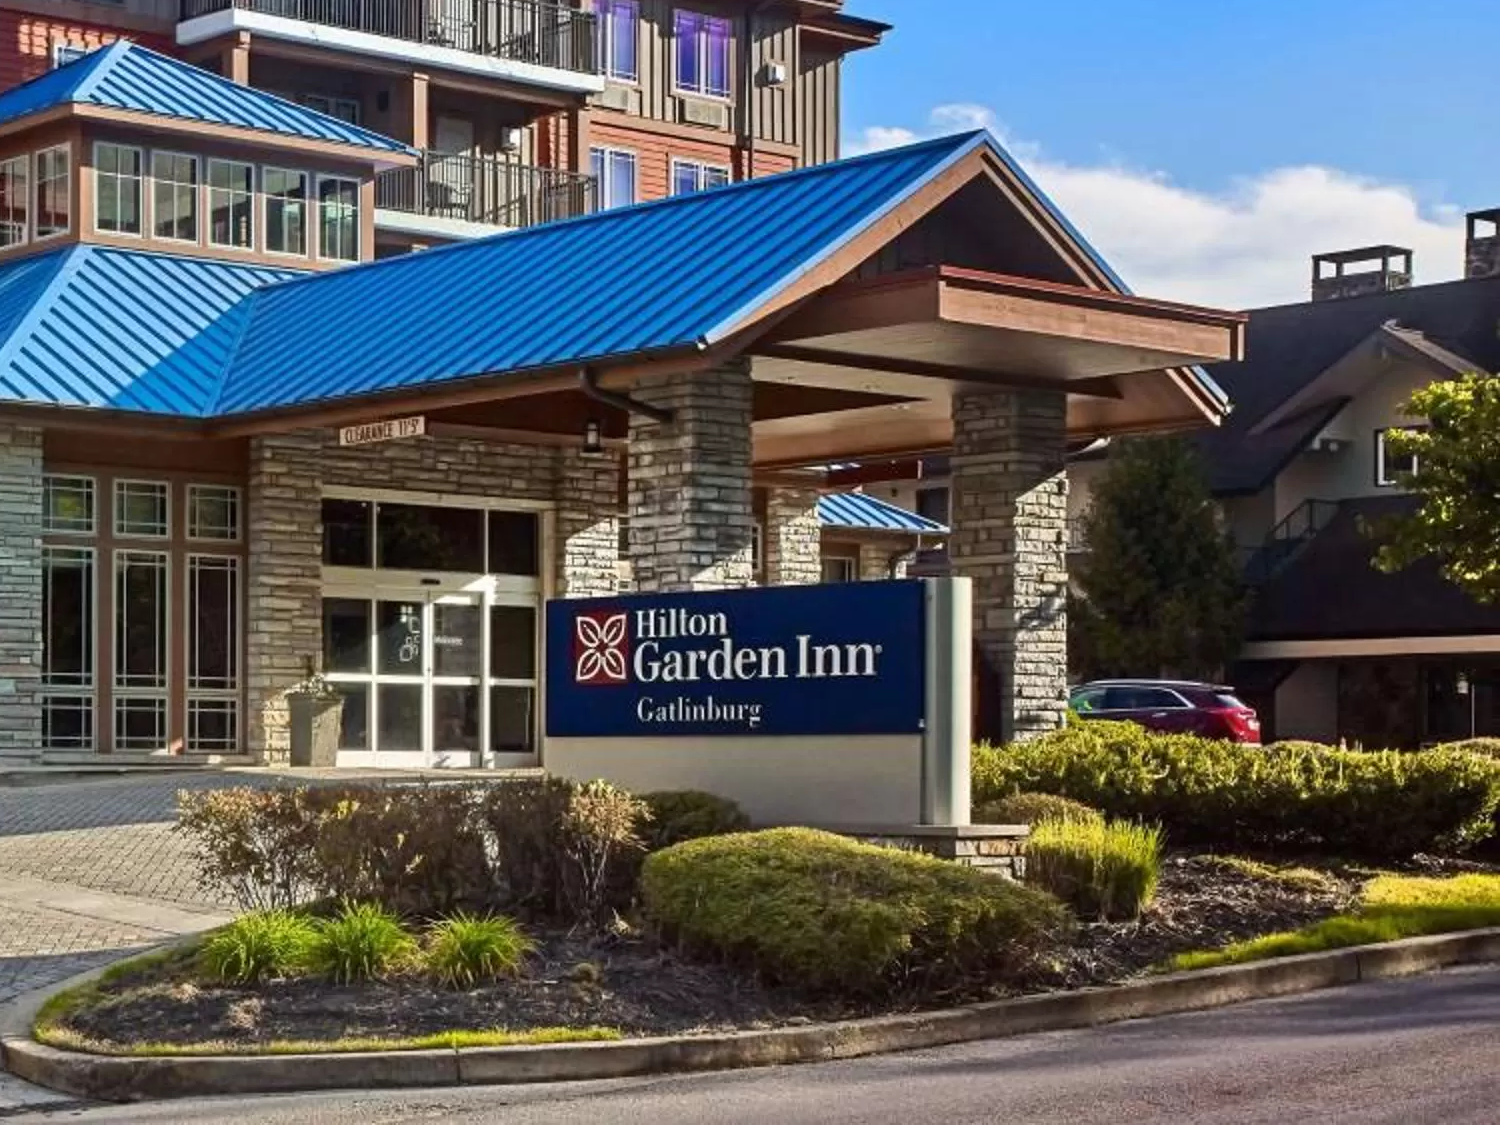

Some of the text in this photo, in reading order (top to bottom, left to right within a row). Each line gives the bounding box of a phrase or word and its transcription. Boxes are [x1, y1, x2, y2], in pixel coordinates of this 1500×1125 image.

[636, 608, 729, 638] Hilton
[633, 635, 878, 682] Garden Inn
[637, 696, 762, 727] Gatlinburg
